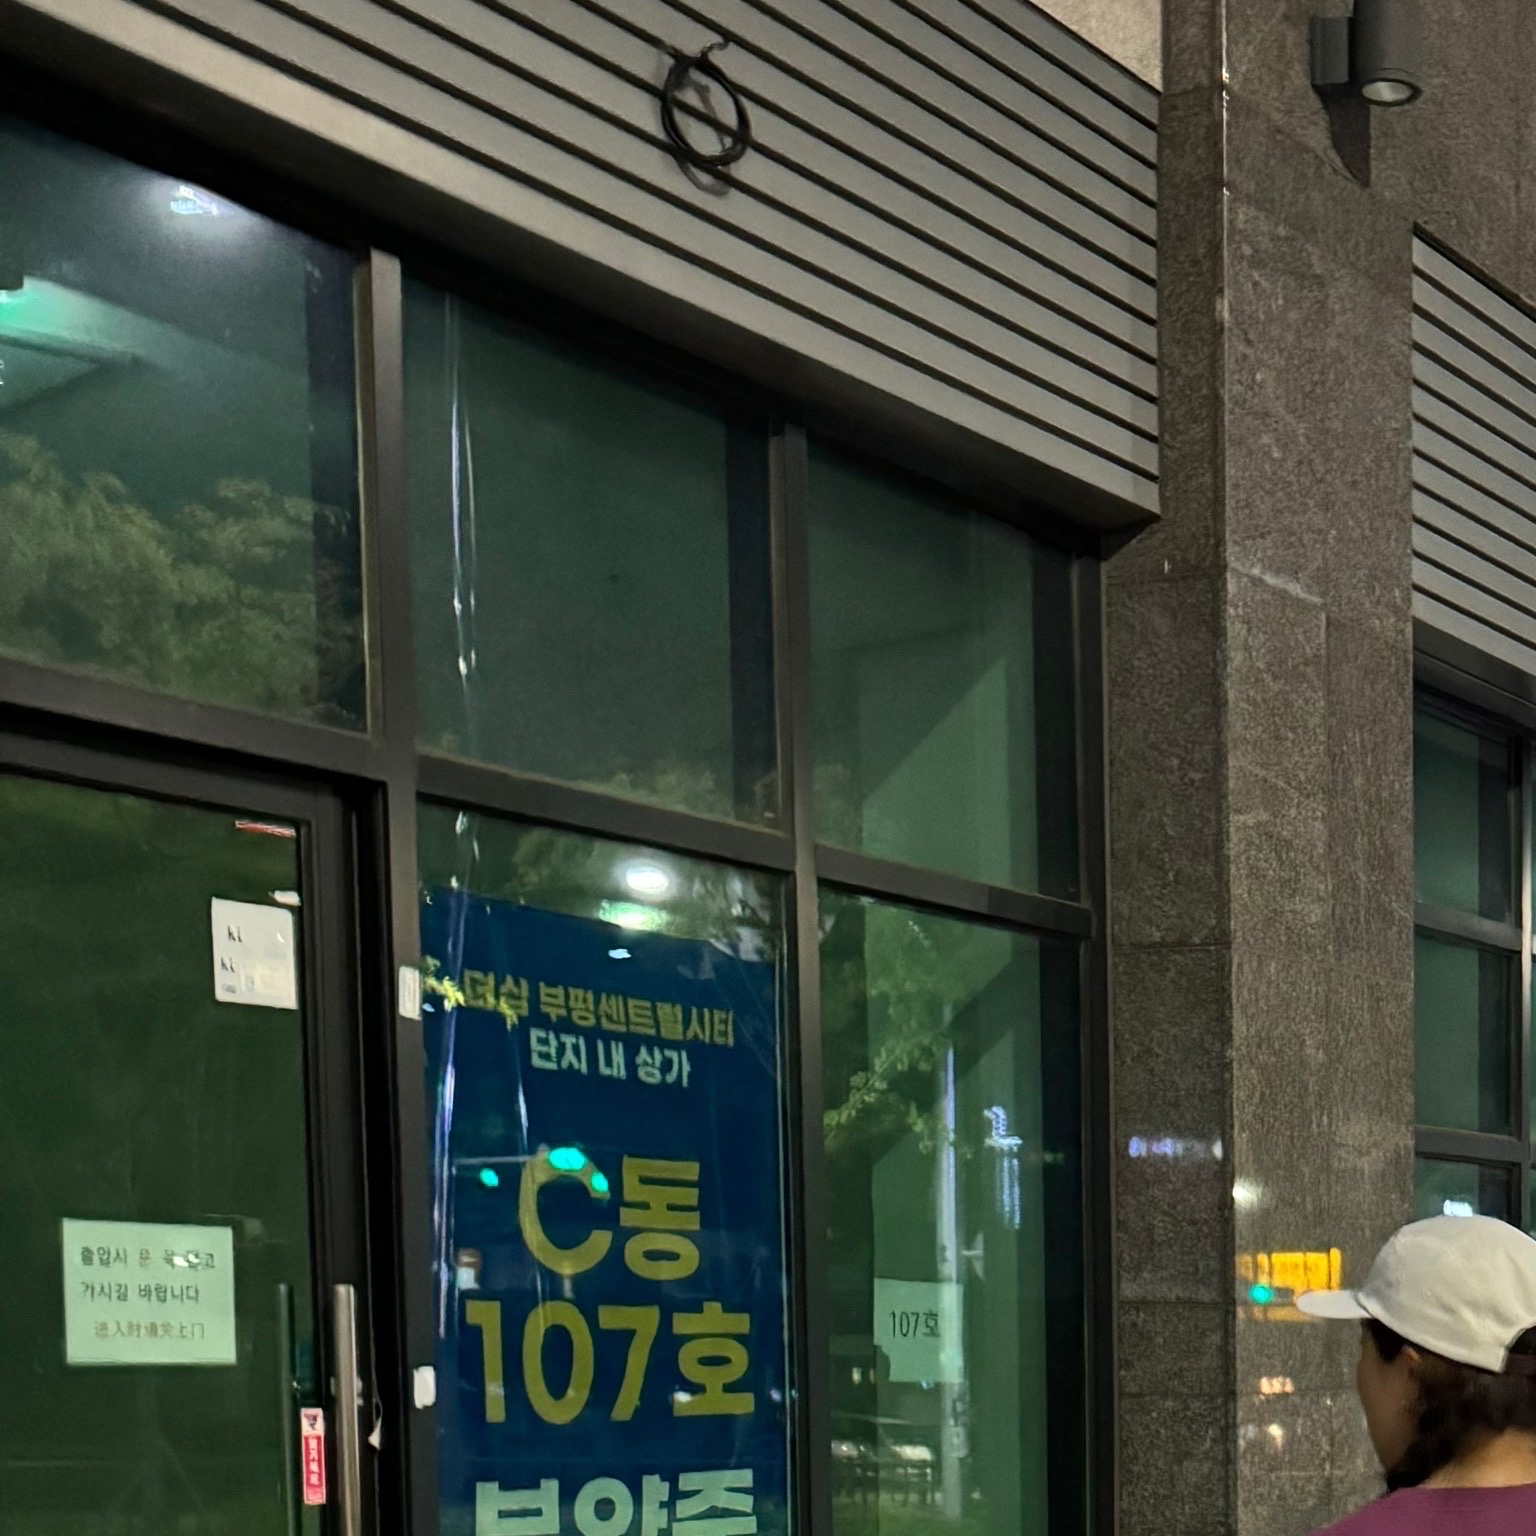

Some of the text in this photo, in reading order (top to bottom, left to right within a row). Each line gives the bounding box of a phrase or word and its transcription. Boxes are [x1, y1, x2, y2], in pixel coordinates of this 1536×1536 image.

[538, 981, 734, 1047] 부평센트럴시티
[530, 1027, 691, 1088] 단지 내 상가
[519, 1148, 701, 1281] C동
[138, 1283, 200, 1304] 바랍니다
[891, 1310, 941, 1338] 107호
[465, 1299, 755, 1425] 107호
